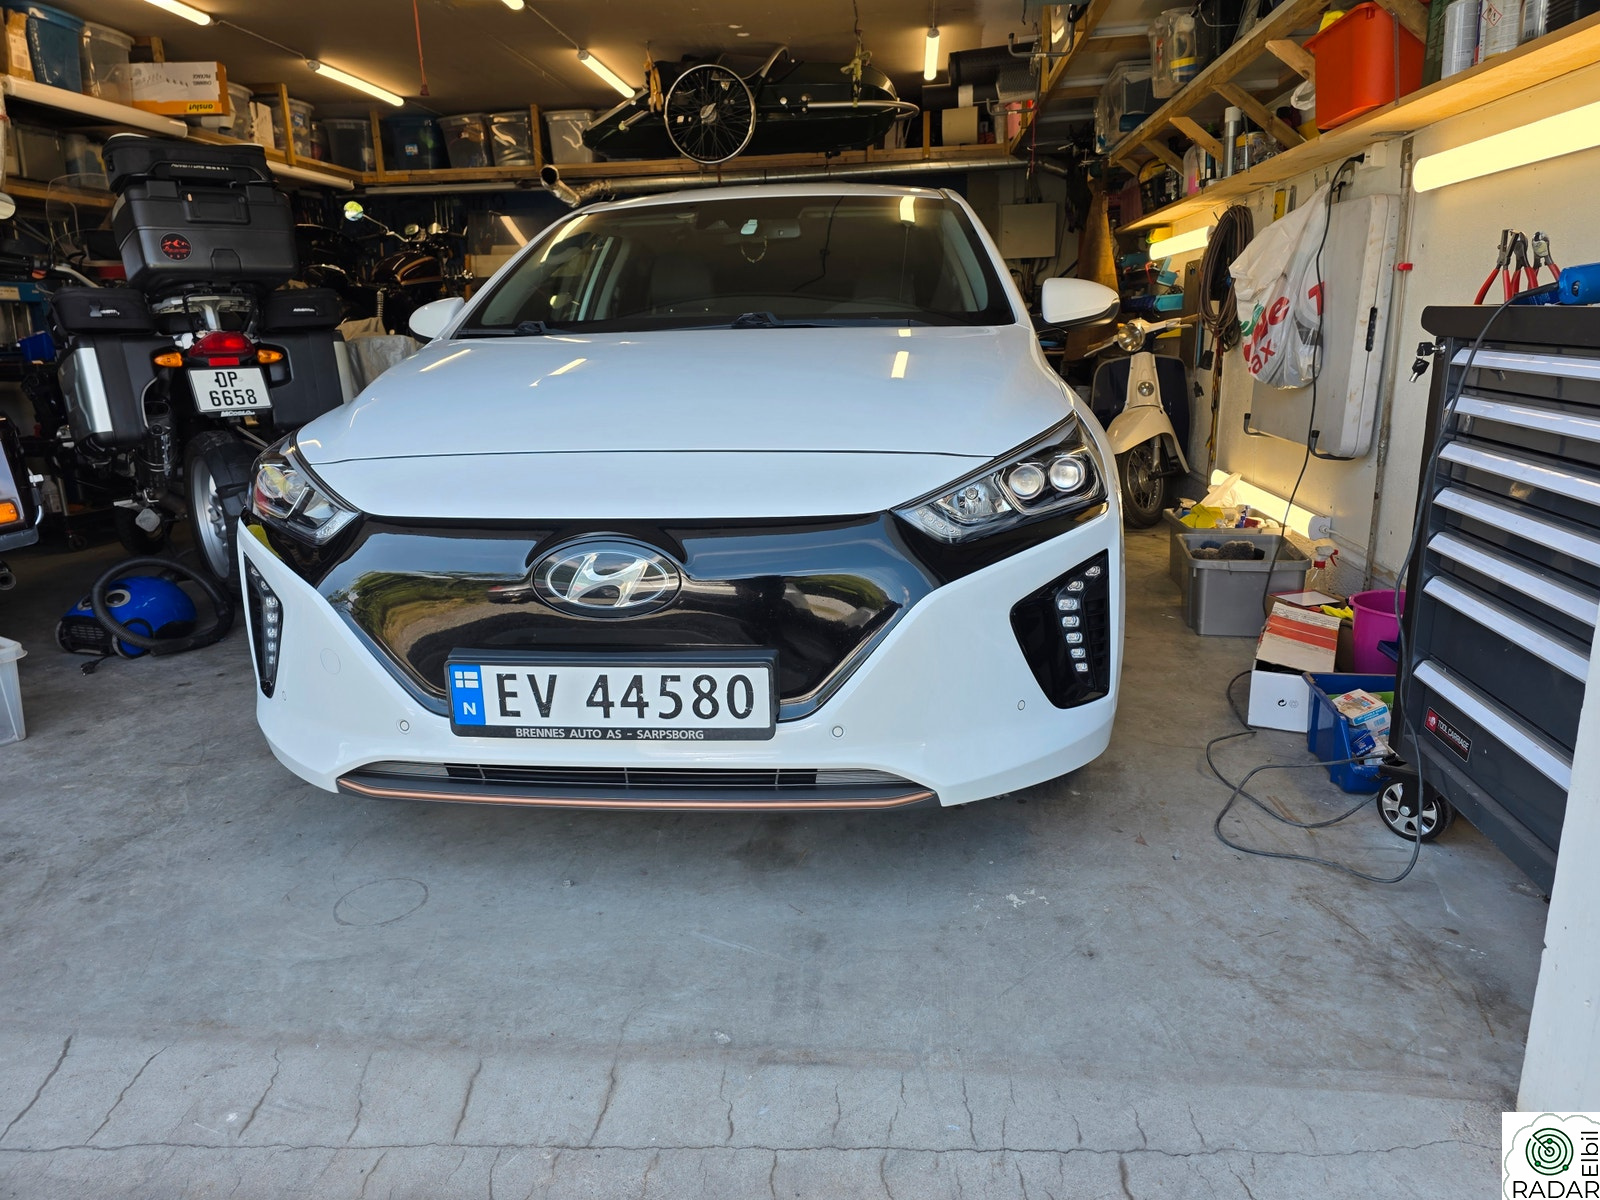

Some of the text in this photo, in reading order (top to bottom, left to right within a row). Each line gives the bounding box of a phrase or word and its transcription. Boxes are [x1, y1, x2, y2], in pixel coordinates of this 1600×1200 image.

[188, 103, 214, 112] anslut
[214, 371, 238, 388] DP
[209, 388, 258, 407] 6658
[496, 673, 755, 720] EV 44580
[462, 702, 477, 716] N
[515, 728, 566, 738] BRENNES
[569, 729, 602, 739] AUTO
[606, 729, 622, 739] AS
[636, 729, 704, 740] SARPSBORG
